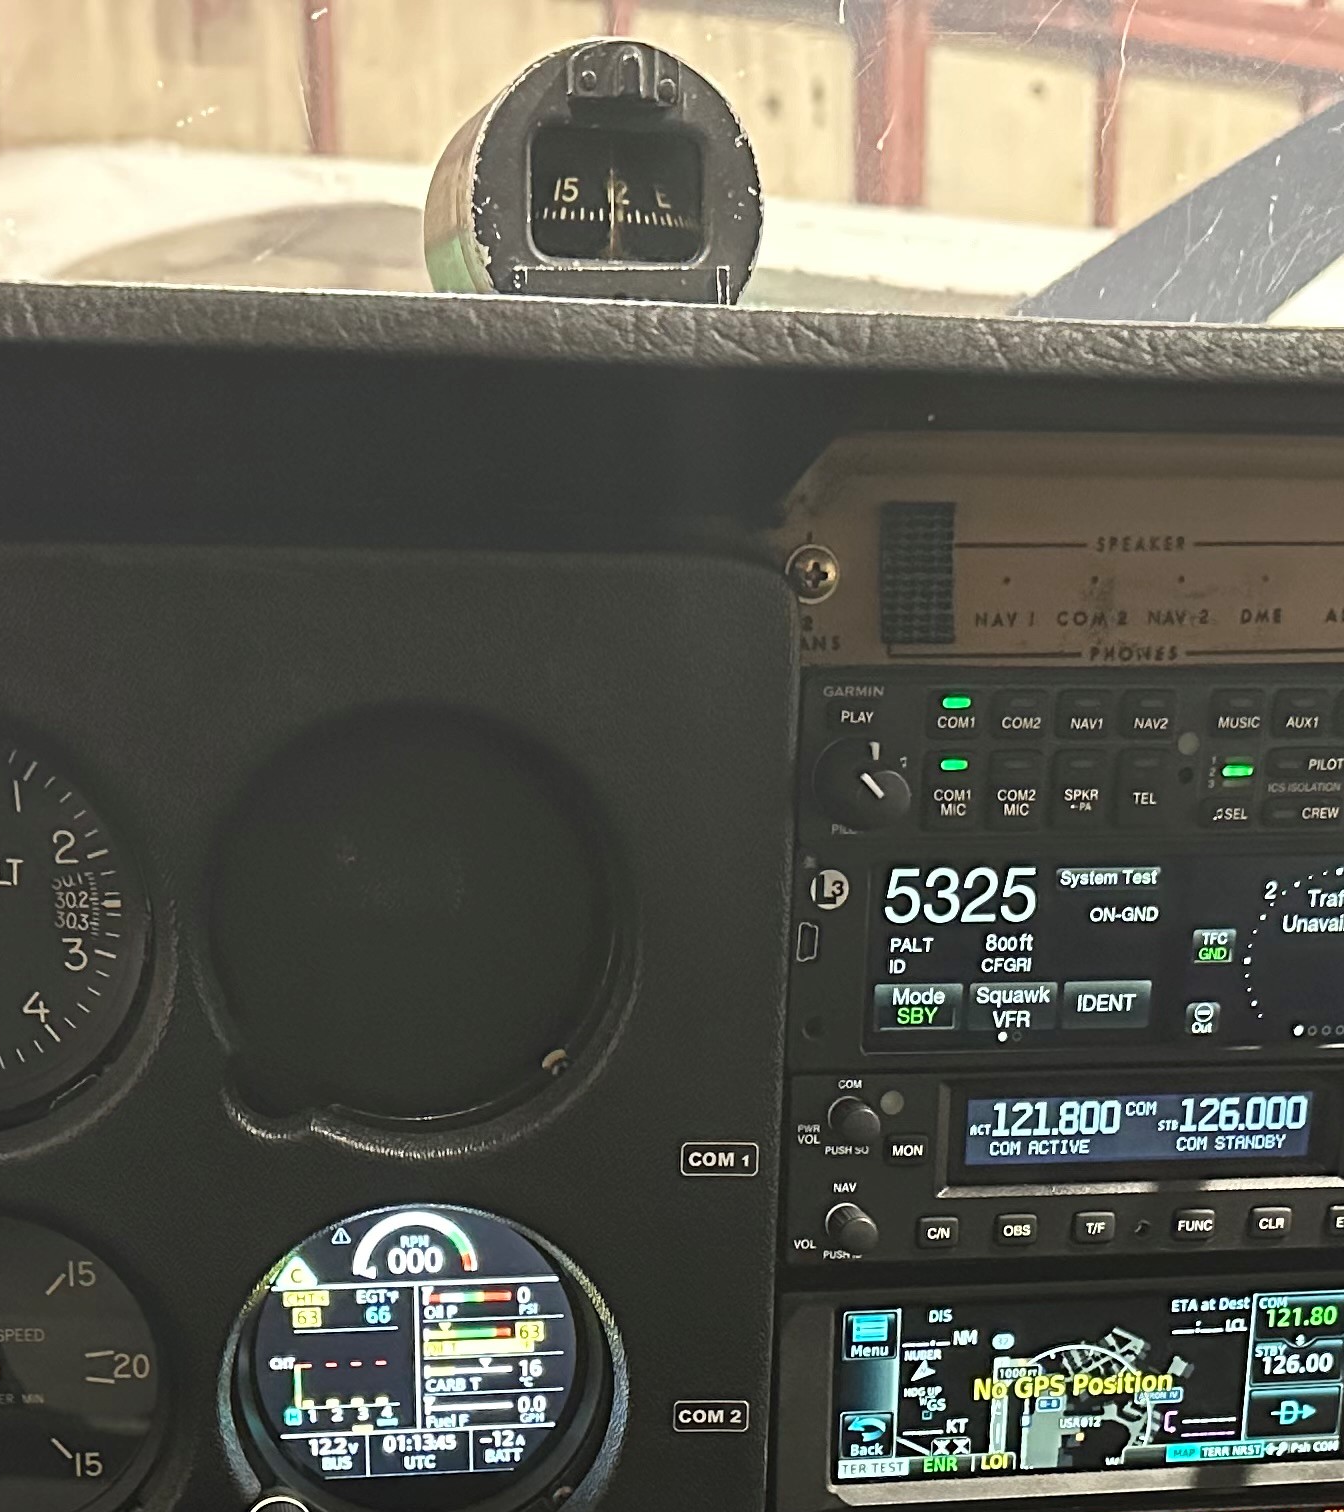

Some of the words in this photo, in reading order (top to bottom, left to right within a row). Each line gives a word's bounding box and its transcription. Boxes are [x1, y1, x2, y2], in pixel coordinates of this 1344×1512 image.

[555, 177, 578, 202] 15
[1095, 535, 1186, 553] SPEAKER
[975, 612, 1018, 628] NAV
[1057, 611, 1110, 628] COM
[1117, 610, 1129, 626] 2
[1148, 611, 1190, 627] NAV
[1240, 609, 1283, 625] DME
[1090, 645, 1180, 662] PHONES
[841, 711, 874, 724] PLAY
[937, 716, 976, 730] COM1
[1001, 716, 1041, 730] COM2
[1070, 717, 1104, 730] NAV1
[1134, 717, 1169, 730] NAV2
[1218, 716, 1260, 729] MUSIC
[1286, 716, 1319, 729] AUX1
[1308, 758, 1344, 771] PILOT
[934, 789, 972, 801] COM1
[997, 789, 1036, 802] COM2
[1064, 788, 1099, 801] SPKR
[1133, 792, 1157, 805] TEL
[1302, 807, 1340, 819] CREW
[52, 830, 79, 863] 2
[1059, 870, 1118, 888] System
[1122, 869, 1157, 886] Test
[884, 867, 1037, 924] 5325
[1089, 907, 1159, 923] ON-GND
[889, 937, 934, 953] PALT
[985, 933, 1034, 951] 800ft
[889, 959, 906, 974] ID
[981, 958, 1032, 973] CFGRI
[892, 988, 946, 1006] Mode
[976, 987, 1050, 1006] Squawk
[1077, 993, 1136, 1012] IDENT
[897, 1007, 938, 1025] SBY
[992, 1010, 1031, 1028] VFR
[838, 1079, 862, 1089] COM
[991, 1099, 1121, 1137] 121.800
[1179, 1095, 1308, 1133] 126.000
[990, 1141, 1021, 1156] COM
[1029, 1139, 1090, 1155] ACTIVE
[1176, 1136, 1208, 1151] COM
[1215, 1133, 1286, 1150] STANDBY
[892, 1144, 923, 1157] MON
[688, 1152, 735, 1168] COM
[742, 1153, 750, 1167] 1
[1003, 1224, 1031, 1238] OBS
[1086, 1221, 1106, 1235] T/F
[1177, 1220, 1213, 1233] FUNC
[1258, 1217, 1285, 1231] CLR
[927, 1226, 951, 1241] C/N
[388, 1247, 443, 1275] 000
[1266, 1305, 1338, 1328] 121.80
[850, 1344, 889, 1358] Menu
[113, 1353, 150, 1379] 20
[1261, 1353, 1334, 1376] 126.00
[973, 1378, 1007, 1402] No
[1014, 1375, 1067, 1398] GPS
[1072, 1372, 1174, 1396] Position
[678, 1409, 724, 1424] COM
[730, 1409, 742, 1424] 2
[850, 1443, 884, 1457] Back
[404, 1454, 436, 1470] UTC
[922, 1457, 958, 1473] ENR
